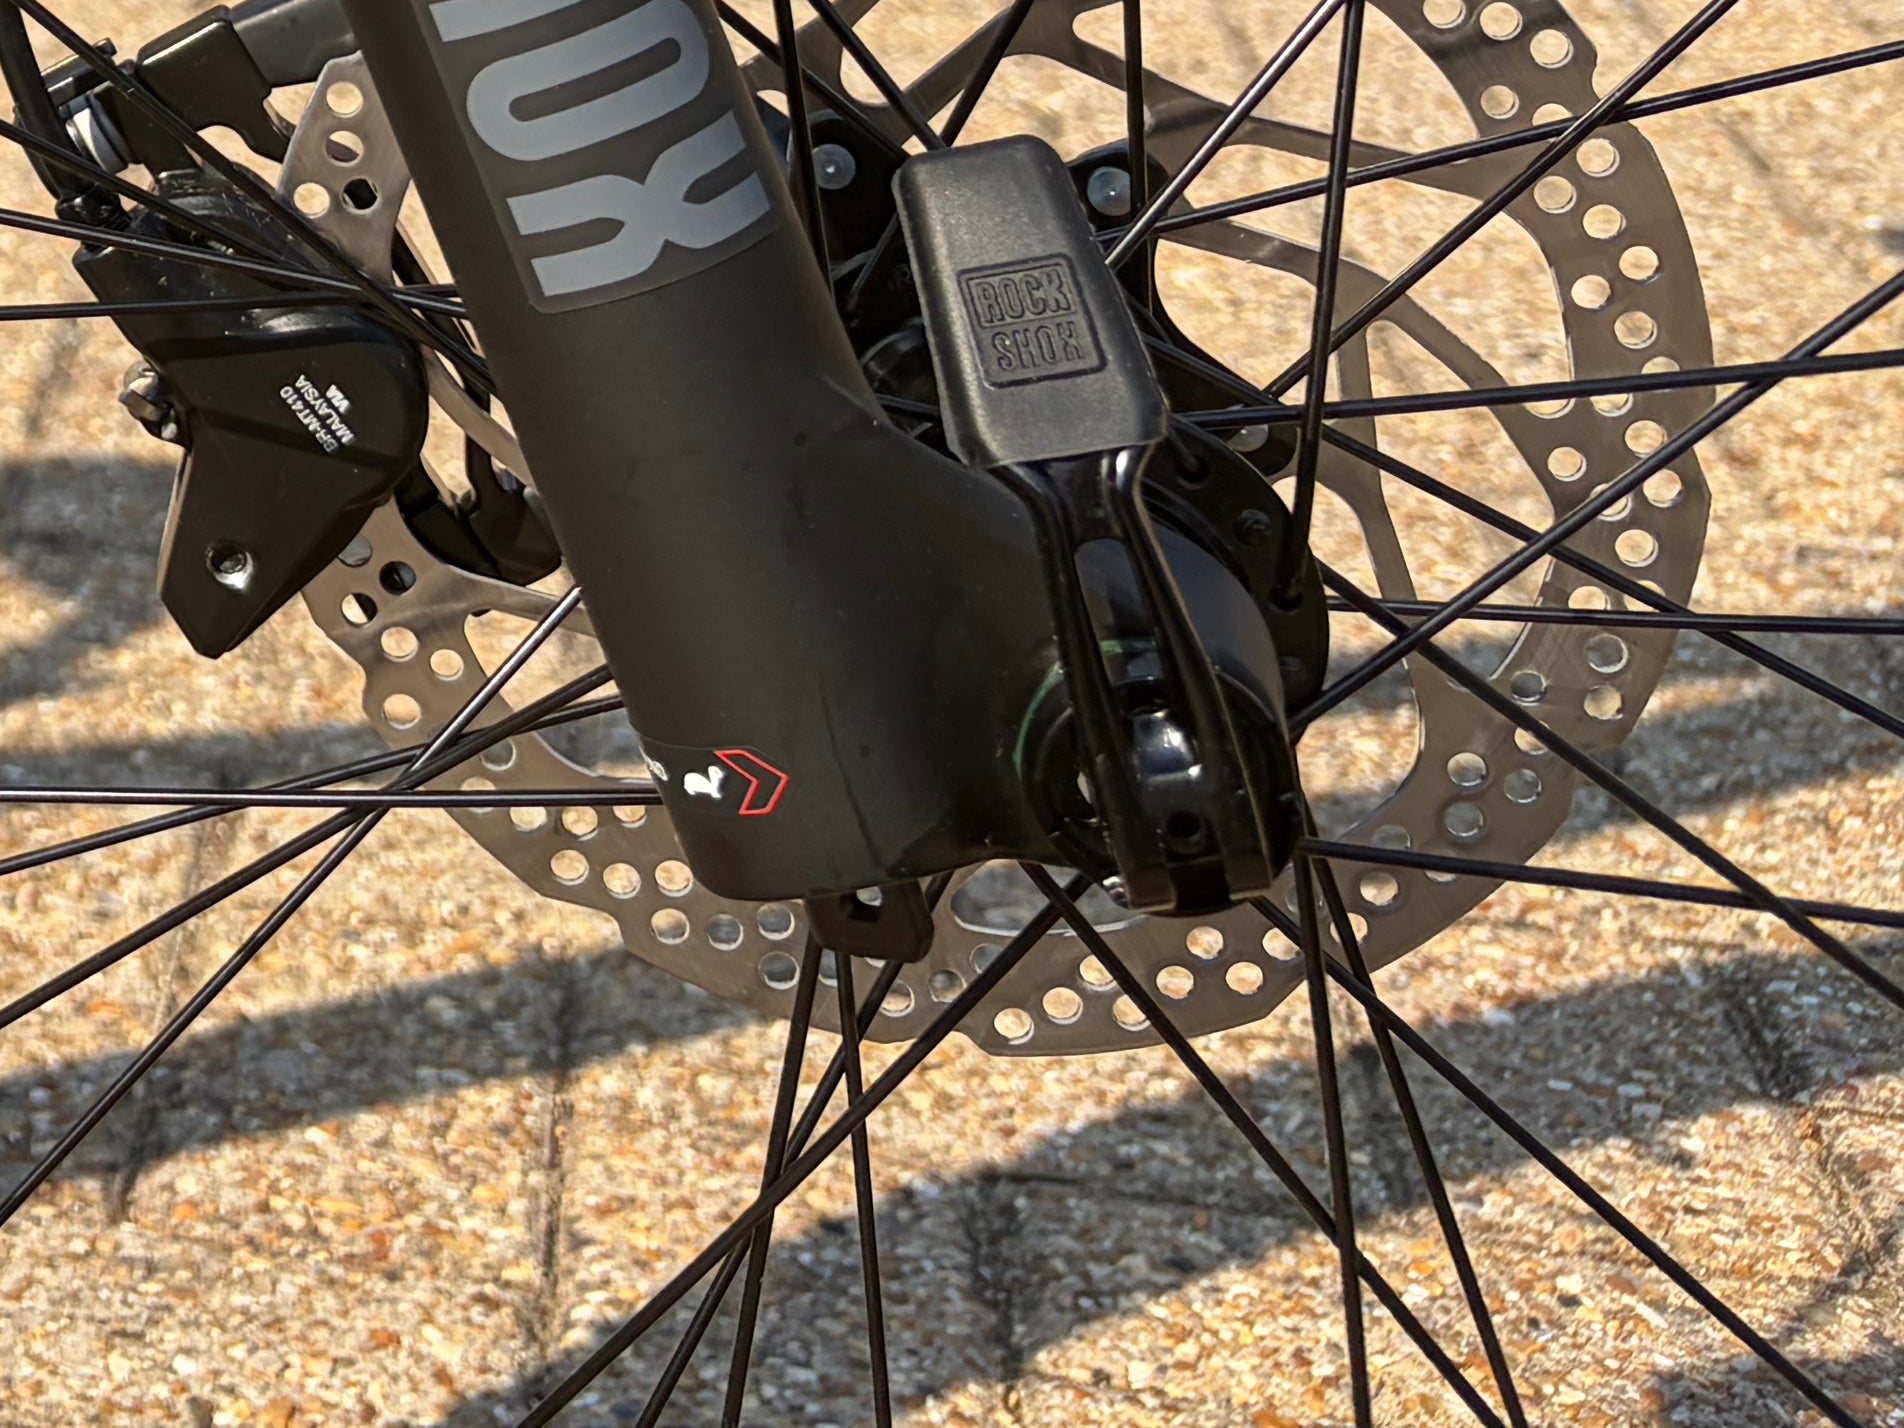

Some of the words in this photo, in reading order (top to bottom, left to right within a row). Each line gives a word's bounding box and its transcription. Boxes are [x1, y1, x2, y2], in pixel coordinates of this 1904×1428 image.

[975, 270, 1071, 323] ROCK
[992, 325, 1084, 371] SHOX
[279, 385, 337, 452] BR-MT410
[294, 375, 353, 443] MALAYSIA
